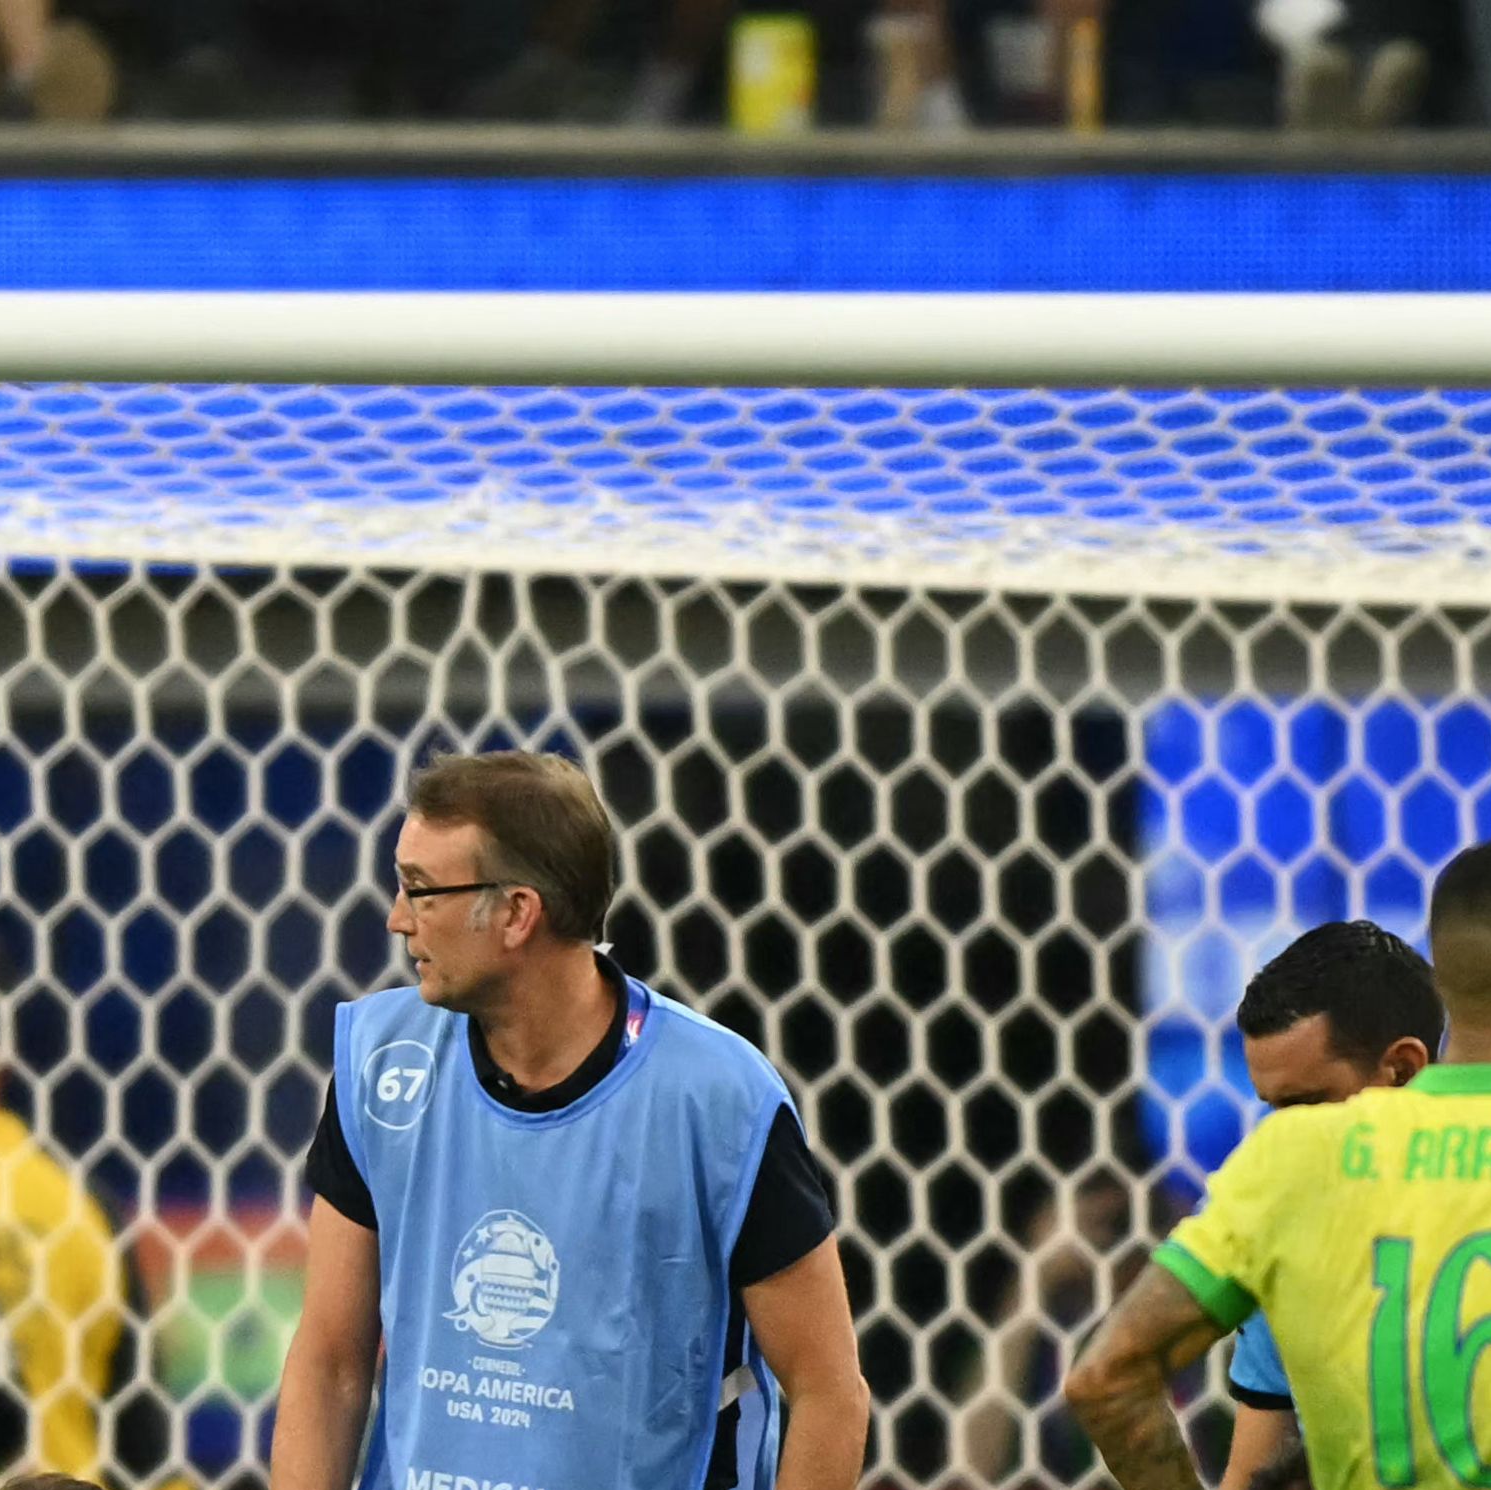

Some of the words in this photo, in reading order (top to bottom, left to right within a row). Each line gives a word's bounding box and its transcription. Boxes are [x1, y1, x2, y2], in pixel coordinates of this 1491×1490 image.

[376, 1067, 426, 1103] 67
[1340, 1120, 1379, 1180] G.
[474, 1376, 575, 1411] AMERICA
[446, 1399, 484, 1424] USA
[489, 1405, 531, 1430] 2024
